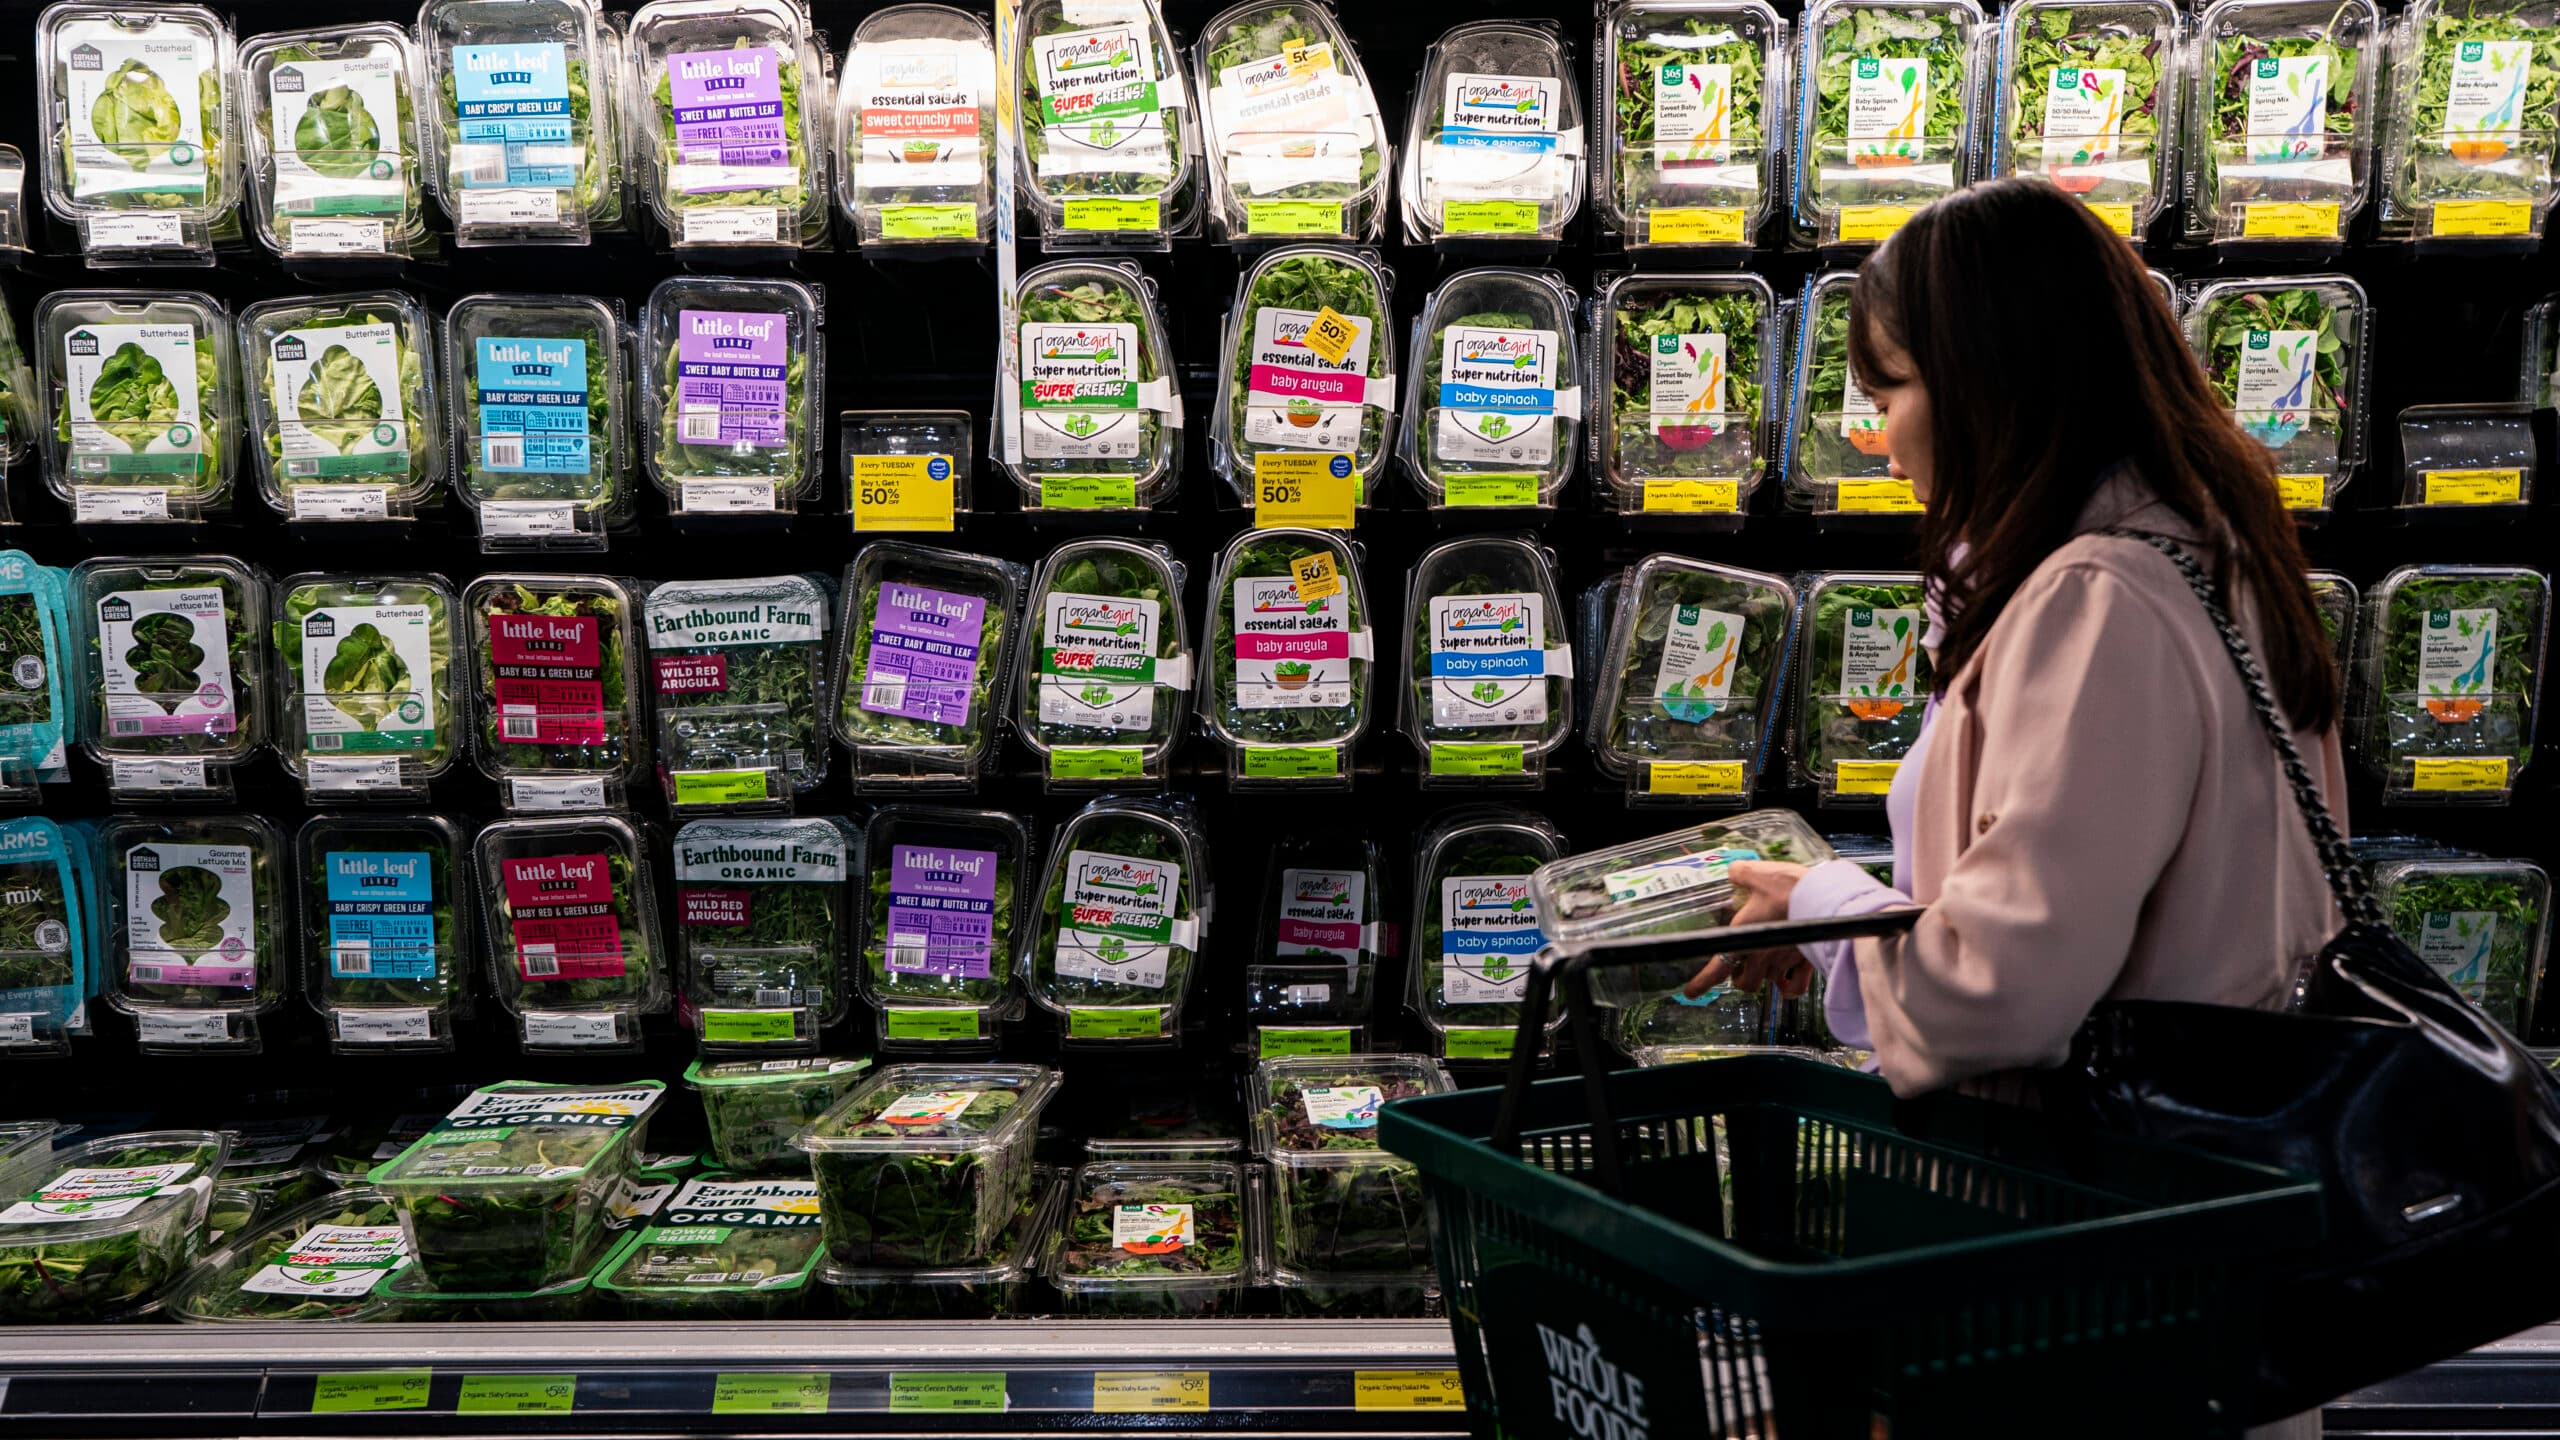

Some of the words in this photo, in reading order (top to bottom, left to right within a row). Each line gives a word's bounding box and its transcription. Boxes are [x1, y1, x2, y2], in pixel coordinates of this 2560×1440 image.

[145, 44, 192, 54] Butterhead
[1059, 34, 1126, 66] organicgirl
[73, 52, 101, 62] GOTHAM
[467, 52, 510, 72] little
[514, 51, 551, 72] leaf
[73, 60, 101, 69] GREENS
[344, 62, 389, 71] Butterhead
[1860, 61, 1877, 73] 365
[1049, 76, 1081, 91] super
[1083, 69, 1137, 86] nutrition
[872, 93, 925, 105] essential
[928, 93, 967, 105] salads
[1054, 93, 1094, 112] SUPER
[1095, 83, 1147, 105] GREENS!
[1872, 98, 1898, 106] Spinach
[465, 103, 486, 115] BABY
[487, 102, 514, 114] CRISPY
[517, 102, 541, 114] GREEN
[543, 102, 562, 112] LEAF
[867, 115, 900, 127] sweet
[904, 113, 950, 128] crunchy
[953, 113, 973, 125] mix
[140, 329, 189, 338] Butterhead
[345, 328, 390, 338] Butterhead
[692, 318, 734, 336] little
[738, 319, 773, 341] leaf
[1320, 320, 1347, 340] 50%
[71, 339, 96, 347] GOTHAM
[713, 338, 752, 349] FARMS
[1046, 335, 1113, 352] organicgirl
[1660, 338, 1677, 348] 365
[2251, 334, 2268, 343] 365
[1467, 340, 1531, 357] organicgirl
[490, 344, 531, 363] little
[537, 346, 572, 366] leaf
[1262, 353, 1313, 364] essential
[513, 365, 552, 375] FARMS
[685, 365, 710, 374] SWEET
[711, 365, 730, 376] BABY
[733, 367, 760, 377] BUTTER
[762, 368, 779, 378] LEAF
[1033, 365, 1065, 377] super
[1067, 364, 1120, 377] nutrition
[1452, 370, 1483, 382] super
[1486, 371, 1538, 382] nutrition
[1676, 372, 1692, 380] Baby
[1271, 374, 1298, 390] baby
[1301, 377, 1343, 393] arugula
[1034, 384, 1074, 397] SUPER
[1074, 383, 1127, 396] GREENS!
[486, 393, 506, 402] BABY
[508, 393, 534, 403] CRISPY
[537, 394, 560, 403] GREEN
[562, 395, 580, 404] LEAF
[1455, 391, 1487, 406] baby
[1490, 393, 1538, 408] spinach
[502, 410, 521, 422] FREE
[547, 417, 583, 427] GROWN
[861, 462, 879, 470] Every
[862, 488, 899, 504] 50%
[1263, 487, 1301, 502] 50%
[180, 592, 218, 601] Gourmet
[104, 604, 129, 612] GOTHAM
[169, 602, 200, 610] Lettuce
[202, 601, 219, 609] Mix
[104, 612, 130, 620] GREENS
[376, 610, 423, 618] Butterhead
[654, 606, 760, 633] Earthbound
[767, 606, 811, 625] Farm
[1679, 609, 1698, 619] 365
[1855, 611, 1871, 620] 365
[2431, 614, 2448, 622] 365
[1245, 616, 1296, 630] essential
[1300, 616, 1337, 629] salads
[503, 621, 542, 639] little
[549, 622, 584, 644] leaf
[695, 629, 770, 642] ORGANIC
[1256, 639, 1281, 653] baby
[1284, 638, 1327, 652] arugula
[1671, 641, 1685, 649] Baby
[1866, 644, 1890, 652] Spinach
[2427, 645, 2441, 653] Baby
[2444, 645, 2468, 653] Arugula
[500, 668, 519, 677] BABY
[522, 668, 538, 678] RED
[540, 669, 546, 678] &
[548, 669, 572, 678] GREEN
[574, 670, 593, 679] LEAF
[661, 667, 693, 678] WILD
[696, 666, 718, 676] RED
[662, 676, 719, 688] ARUGULA
[209, 850, 246, 858] Gourmet
[683, 846, 785, 866] Earthbound
[792, 846, 838, 867] Farm
[198, 858, 229, 866] Lettuce
[231, 858, 246, 866] Mix
[721, 868, 796, 878] ORGANIC
[1299, 879, 1346, 895] organicgirl
[6, 886, 42, 905] mix
[688, 901, 718, 910] WILD
[721, 901, 743, 910] RED
[688, 912, 744, 921] ARUGULA
[1287, 907, 1325, 919] essential
[1327, 907, 1354, 920] salads
[1293, 927, 1313, 940] baby
[1315, 928, 1345, 941] arugula
[8, 990, 32, 1000] Every
[35, 990, 53, 998] Dish
[481, 1092, 651, 1106] Earthbound
[470, 1104, 543, 1114] Farm
[452, 1115, 627, 1127] ORGANIC
[696, 1186, 818, 1196] Earthbou
[686, 1196, 757, 1207] Farm
[1536, 1322, 1648, 1428] WHOLE
[895, 1385, 923, 1393] Organic
